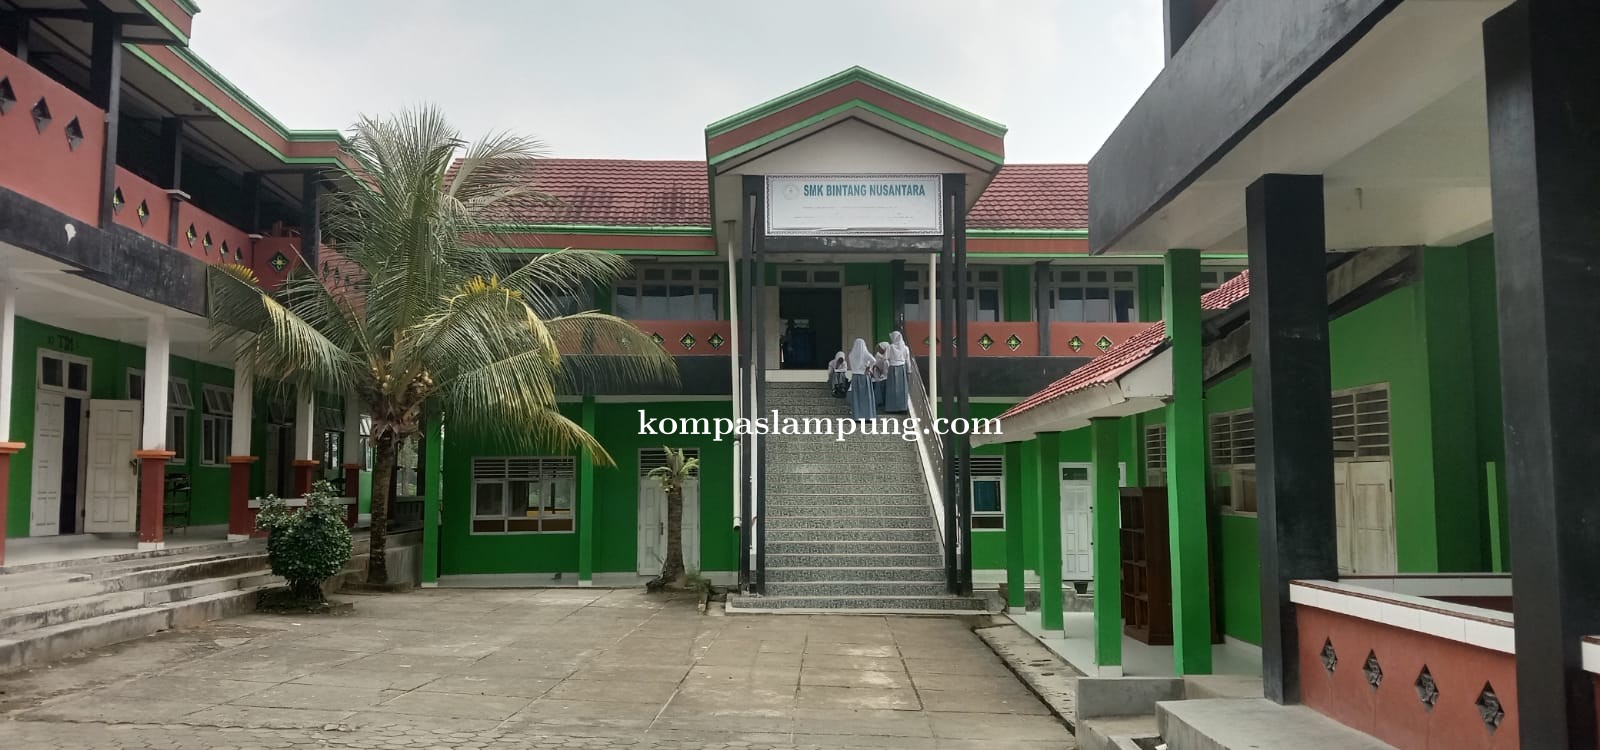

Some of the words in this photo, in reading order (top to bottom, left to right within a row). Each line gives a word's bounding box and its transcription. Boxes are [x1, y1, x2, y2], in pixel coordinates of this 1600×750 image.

[803, 184, 824, 197] SMK
[826, 184, 867, 197] BINTANG
[869, 184, 926, 197] NUSANTARA
